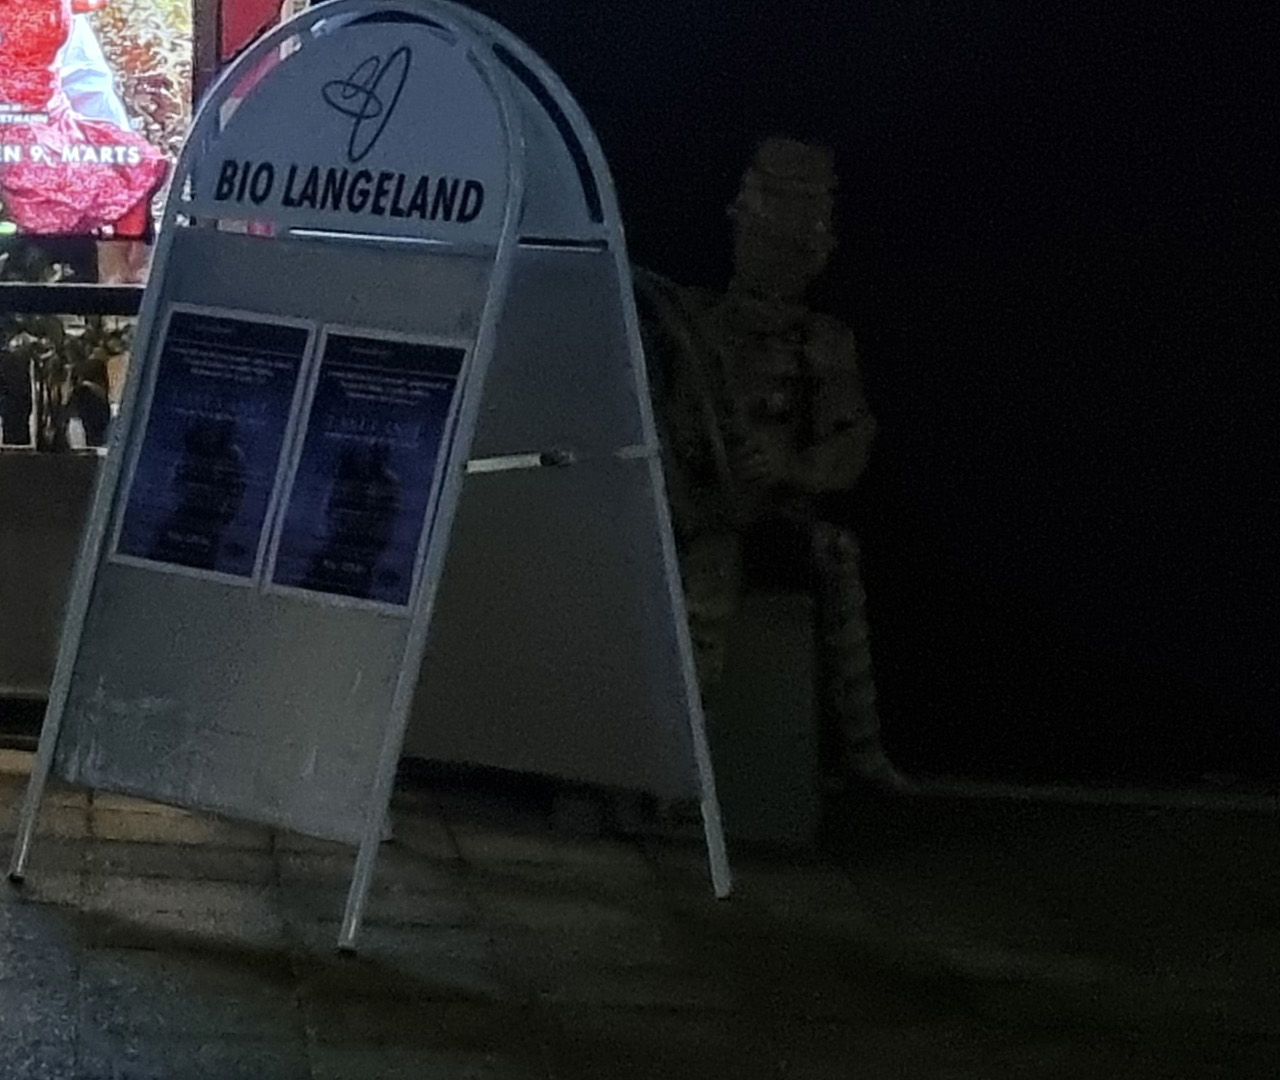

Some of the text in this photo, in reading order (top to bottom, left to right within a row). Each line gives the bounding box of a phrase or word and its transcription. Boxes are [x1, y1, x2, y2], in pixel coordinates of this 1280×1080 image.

[61, 144, 141, 164] MARTS
[214, 159, 485, 224] BIO LANGELAND
